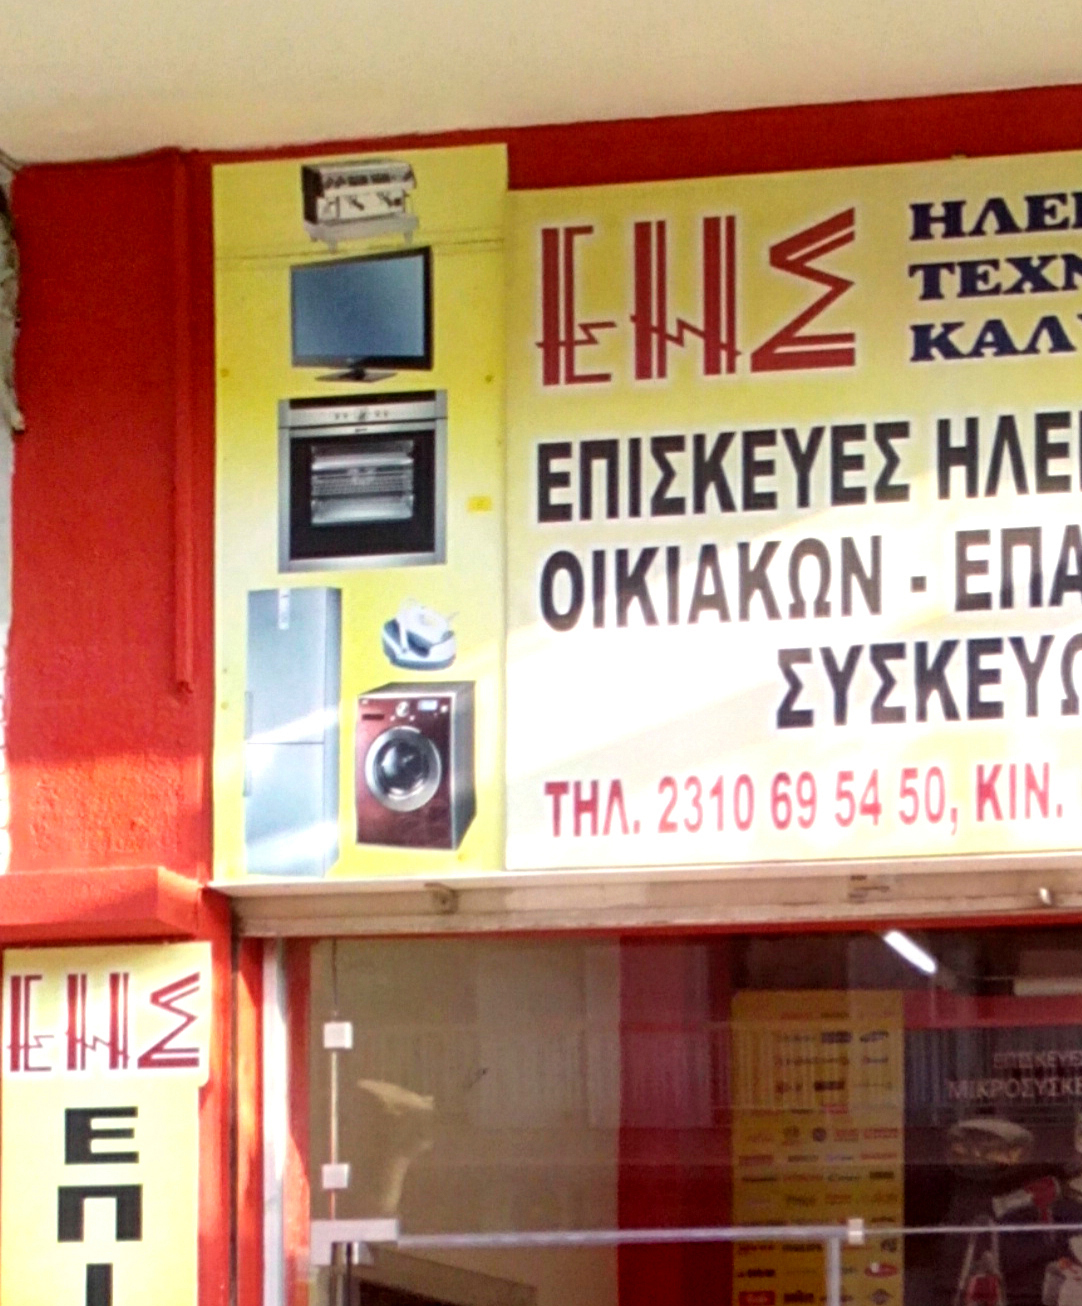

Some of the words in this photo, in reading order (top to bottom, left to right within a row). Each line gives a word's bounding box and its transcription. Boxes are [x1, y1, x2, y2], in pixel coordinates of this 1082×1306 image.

[538, 421, 910, 523] ΕΠΙΣΚΕΥΕΣ
[540, 536, 883, 631] ΟΙΚΙΑΚΩΝ
[544, 781, 641, 837] ΤΗΛ.
[658, 773, 752, 834] 2310
[770, 771, 815, 829] 69
[835, 769, 881, 826] 54
[898, 766, 958, 835] 50,
[976, 762, 1063, 822] ΚΙΝ.
